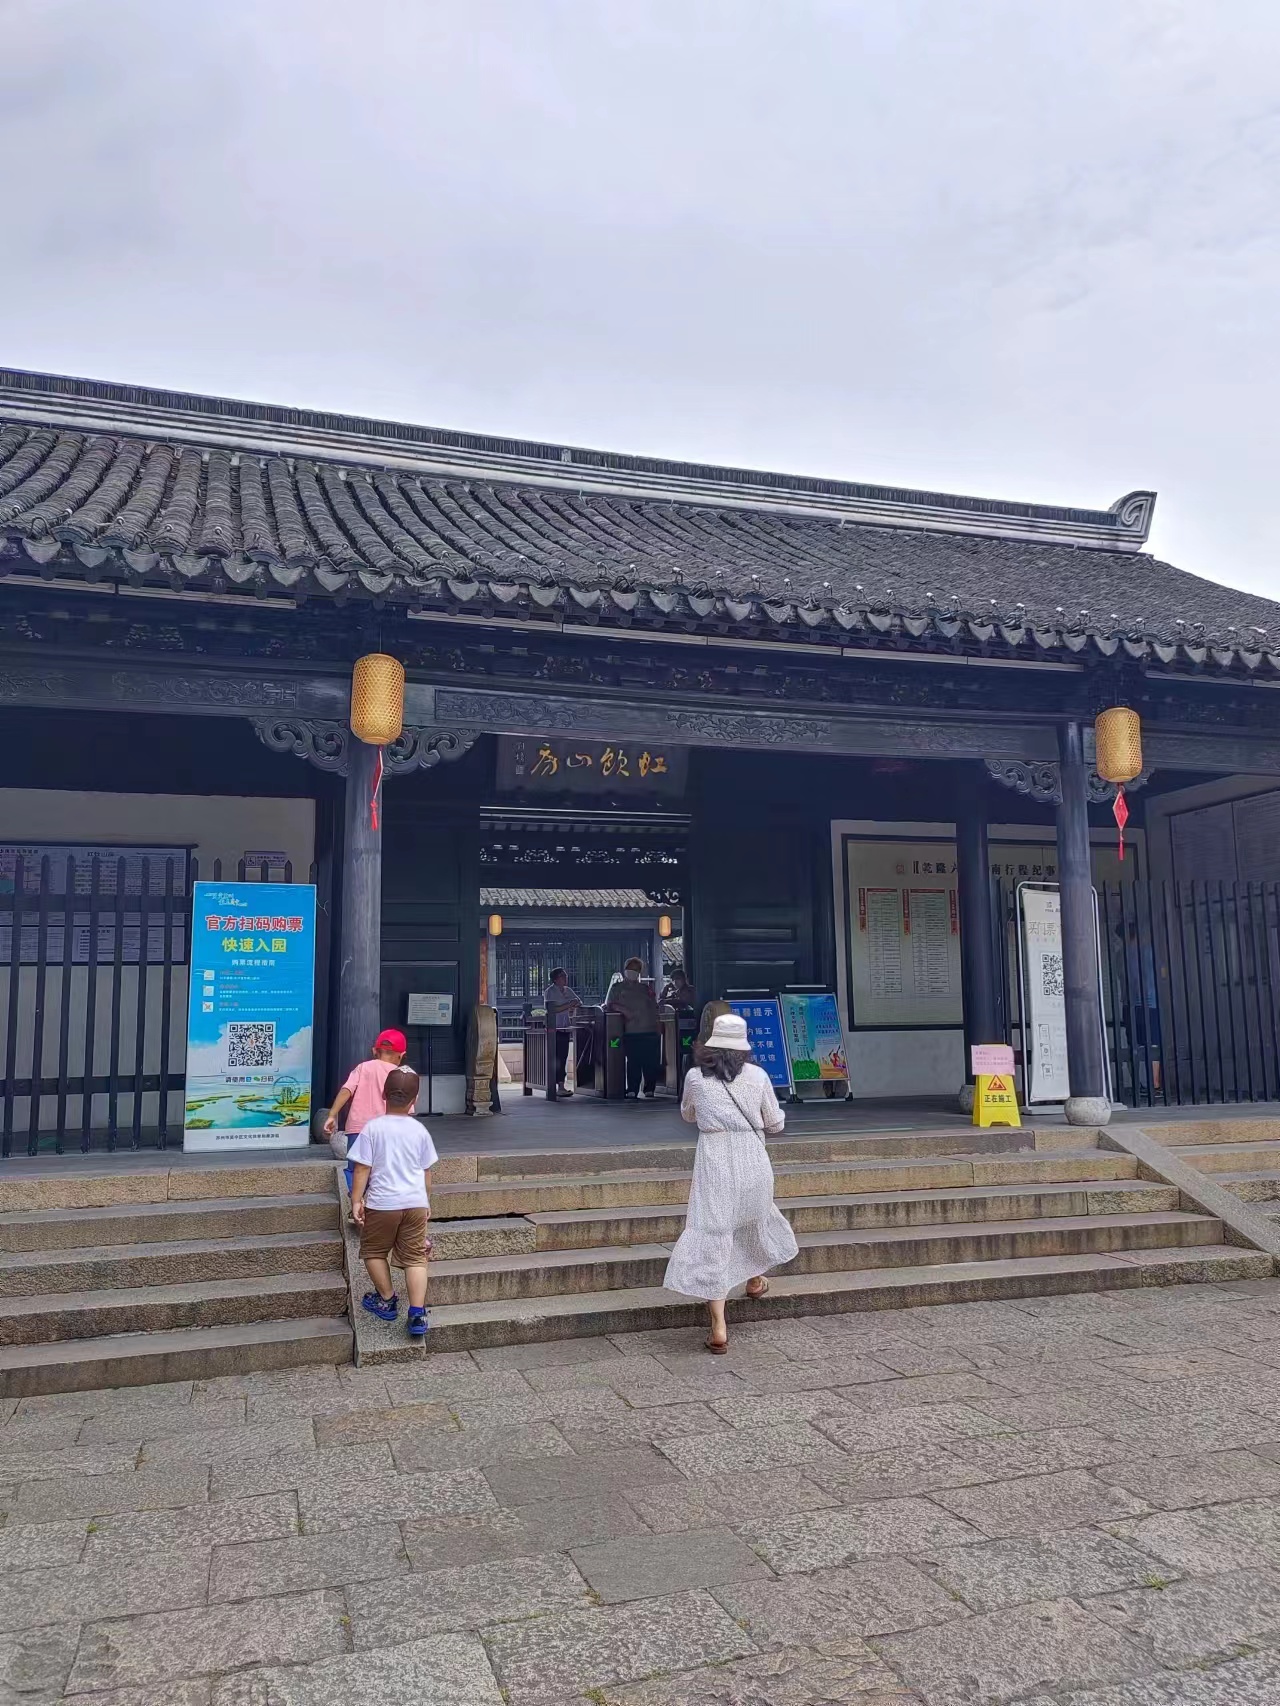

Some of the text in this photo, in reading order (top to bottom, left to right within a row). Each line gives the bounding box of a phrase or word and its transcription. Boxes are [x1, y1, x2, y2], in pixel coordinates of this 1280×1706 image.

[205, 915, 303, 933] 官方扫码购票
[1028, 921, 1059, 936] 买门票
[221, 937, 287, 953] 快速入园
[231, 959, 276, 967] 购票流程指南
[747, 1027, 772, 1036] 内施工
[749, 1040, 775, 1049] 来不便
[749, 1054, 776, 1062] 请见谅
[260, 1075, 274, 1083] 扫码
[984, 1094, 1012, 1103] 正在施工
